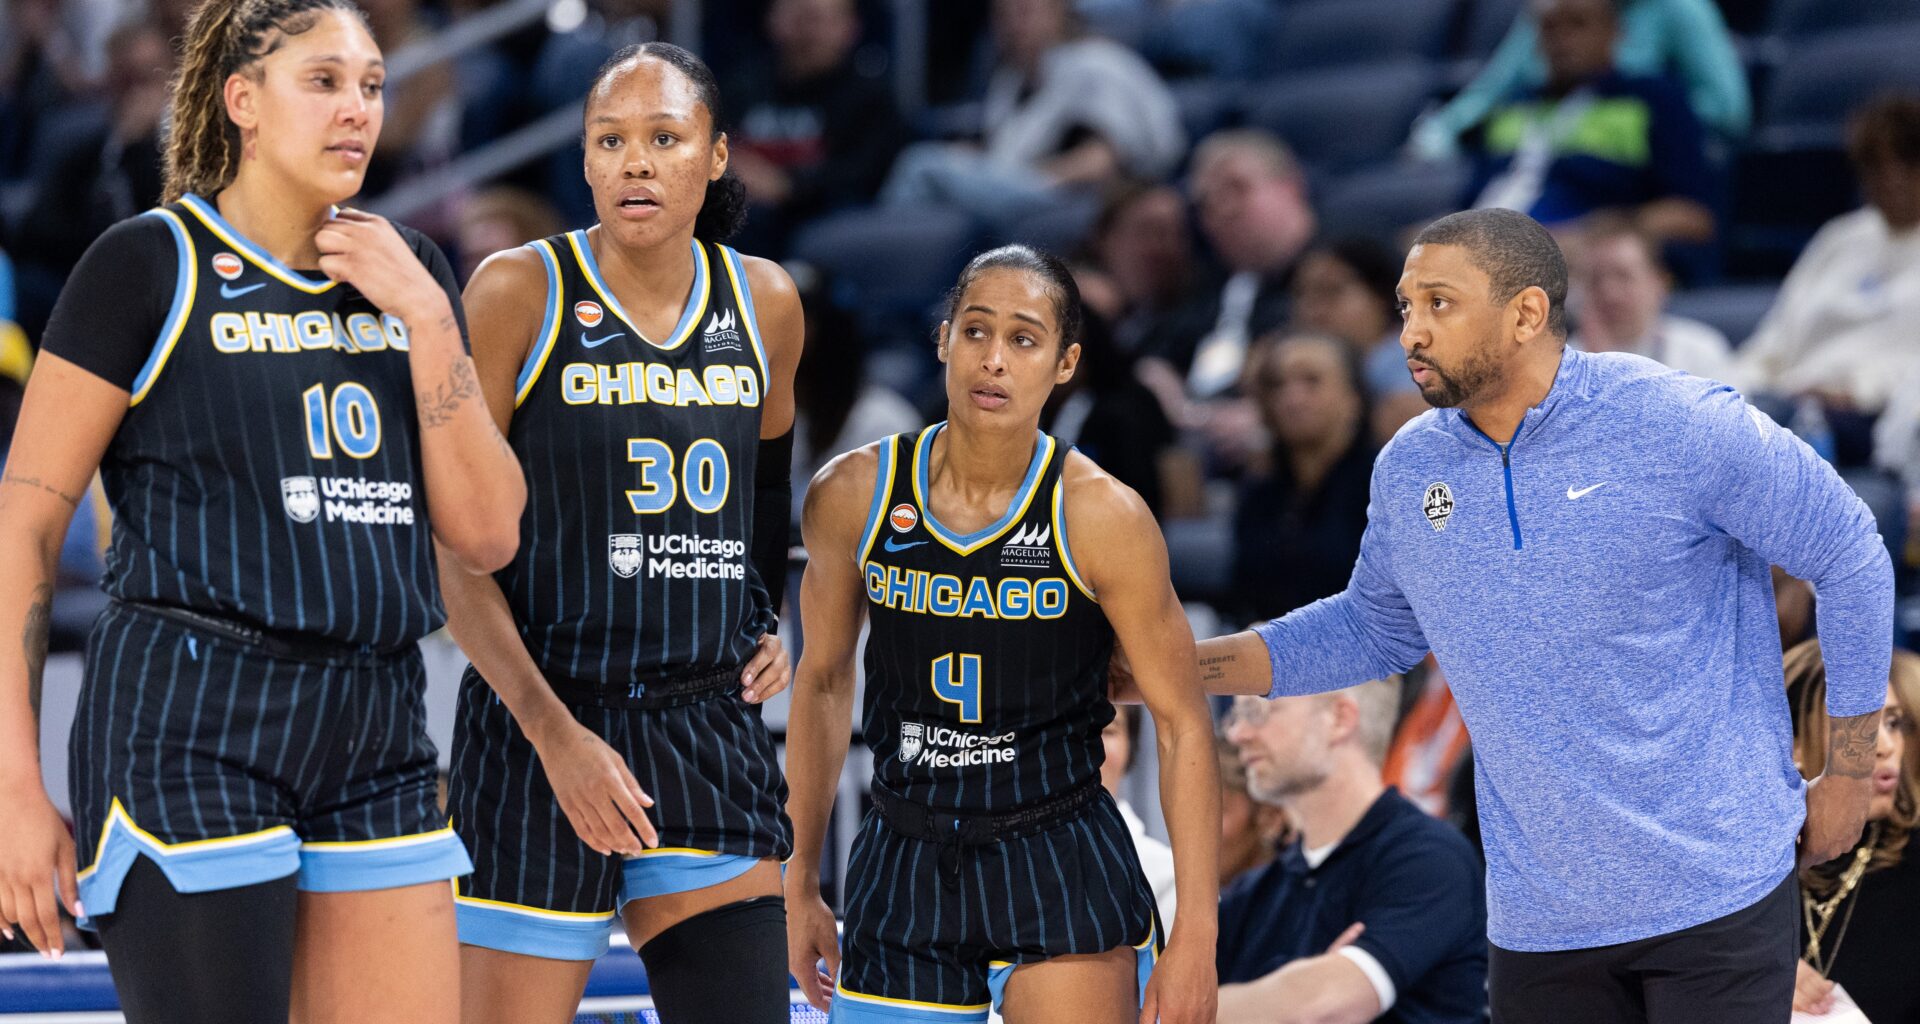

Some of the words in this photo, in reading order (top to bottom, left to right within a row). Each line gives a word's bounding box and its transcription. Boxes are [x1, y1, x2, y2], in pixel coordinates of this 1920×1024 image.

[210, 310, 410, 354] CHICAGO
[561, 362, 760, 408] CHICAGO
[302, 381, 382, 459] 10
[625, 438, 730, 514] 30
[320, 477, 412, 502] UChicago
[324, 500, 414, 525] Medicine
[1428, 504, 1450, 519] SKY
[648, 534, 745, 558] UChicago
[1001, 549, 1050, 557] MAGELLAN
[648, 557, 745, 580] Medicine
[865, 560, 1069, 619] CHICAGO
[931, 652, 982, 723] 4
[917, 744, 1016, 768] Medicine
